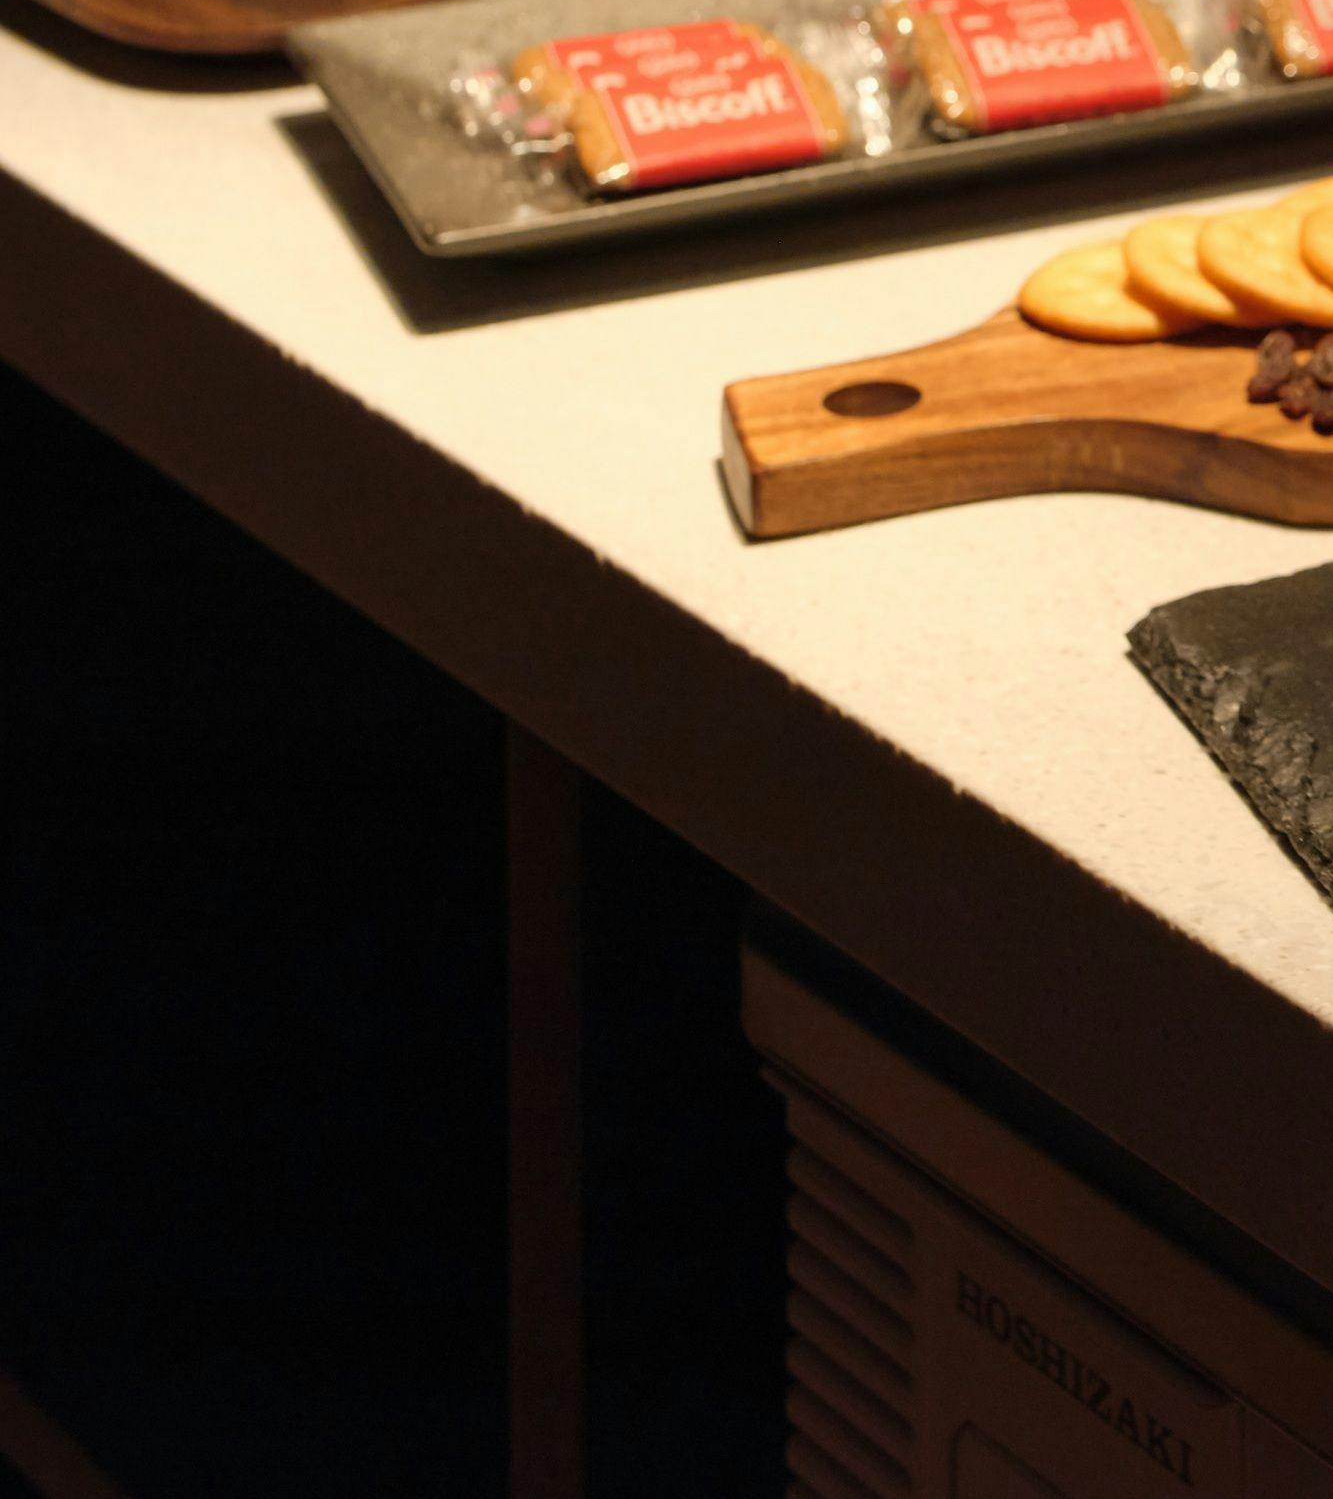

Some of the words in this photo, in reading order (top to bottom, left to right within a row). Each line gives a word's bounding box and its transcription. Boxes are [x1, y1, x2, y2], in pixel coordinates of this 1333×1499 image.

[970, 18, 1132, 78] Biscoff
[622, 72, 788, 136] Biscoff
[956, 1269, 1194, 1487] HOSHIZAKI
